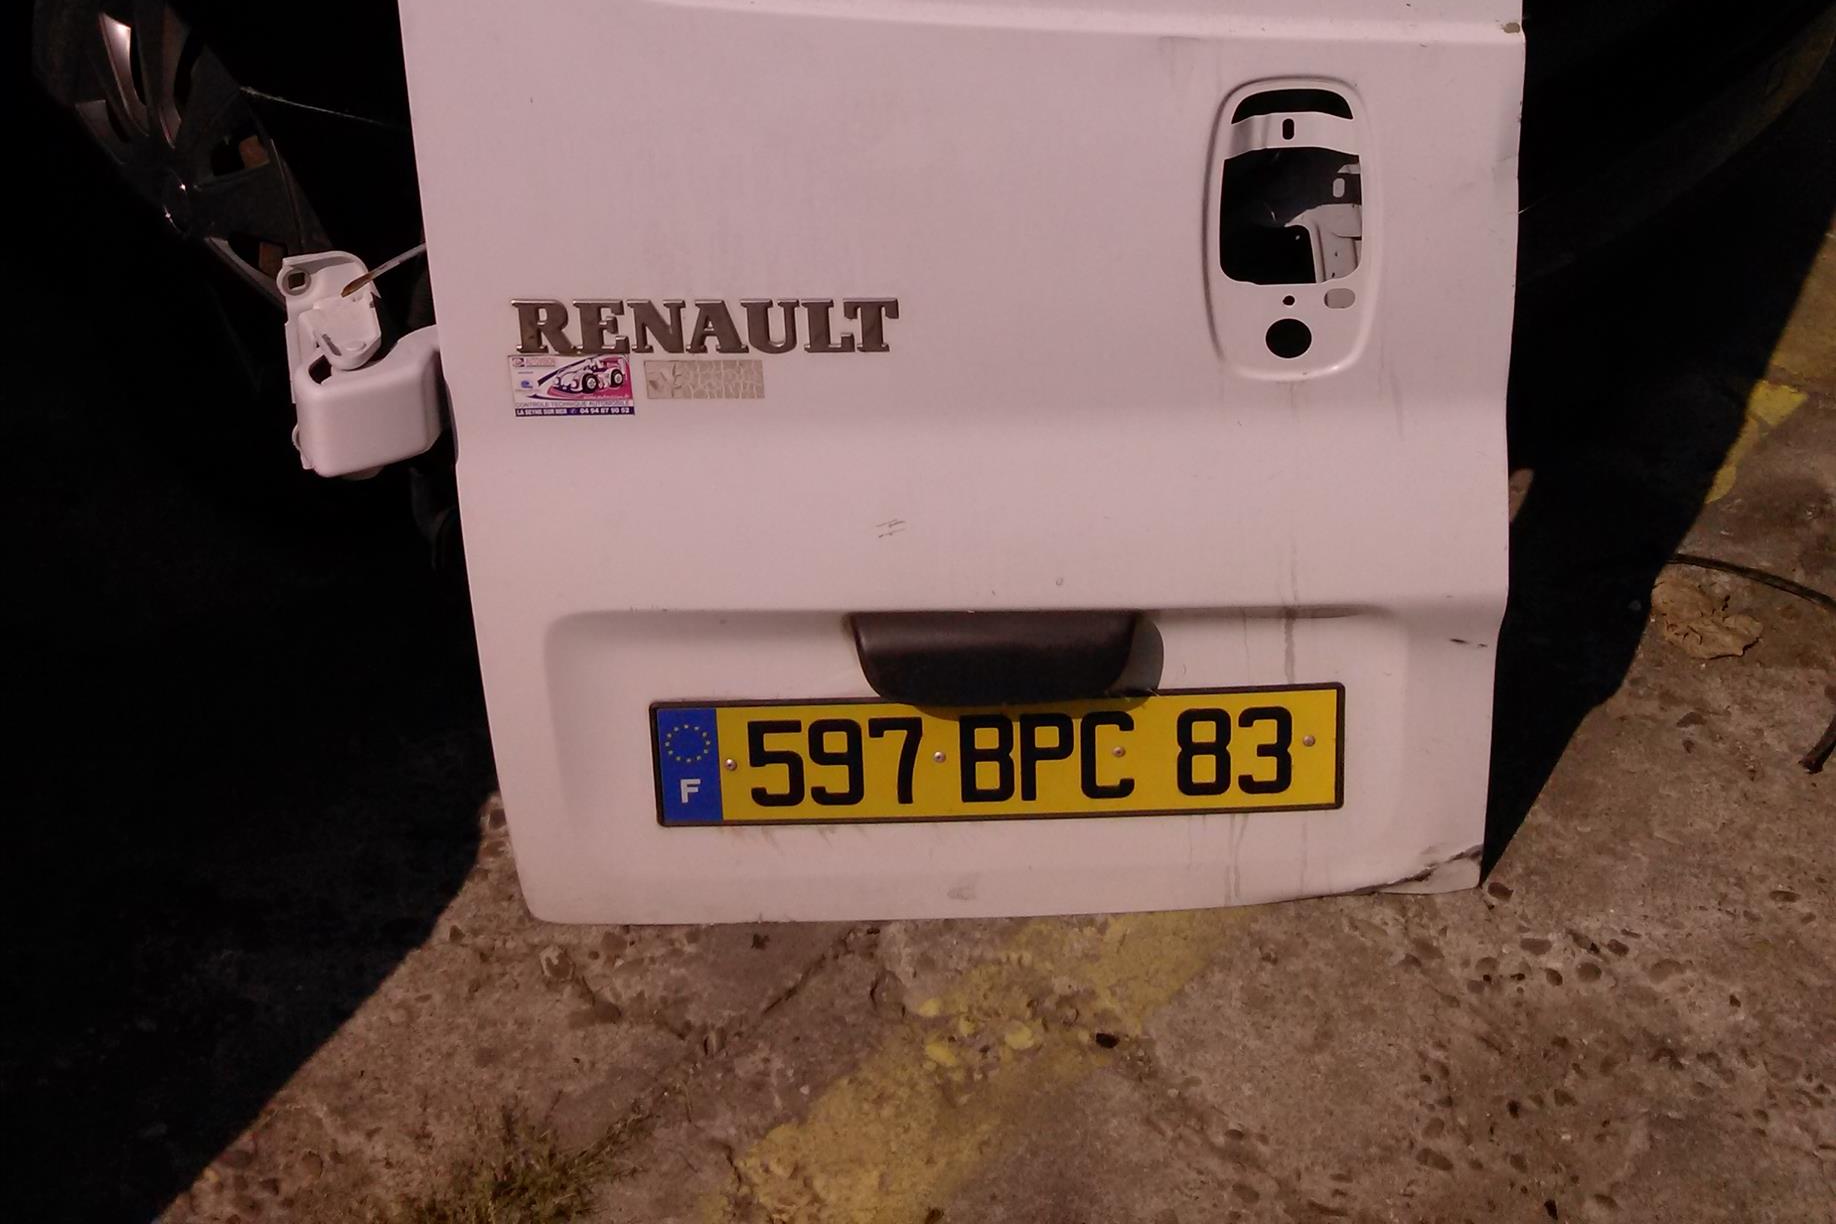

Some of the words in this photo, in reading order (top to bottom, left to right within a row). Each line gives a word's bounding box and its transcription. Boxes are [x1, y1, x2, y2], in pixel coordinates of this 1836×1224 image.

[511, 297, 899, 355] RENAULT
[680, 778, 701, 804] F
[746, 716, 923, 808] 597
[960, 710, 1136, 804] BPC
[1176, 706, 1294, 797] 83
